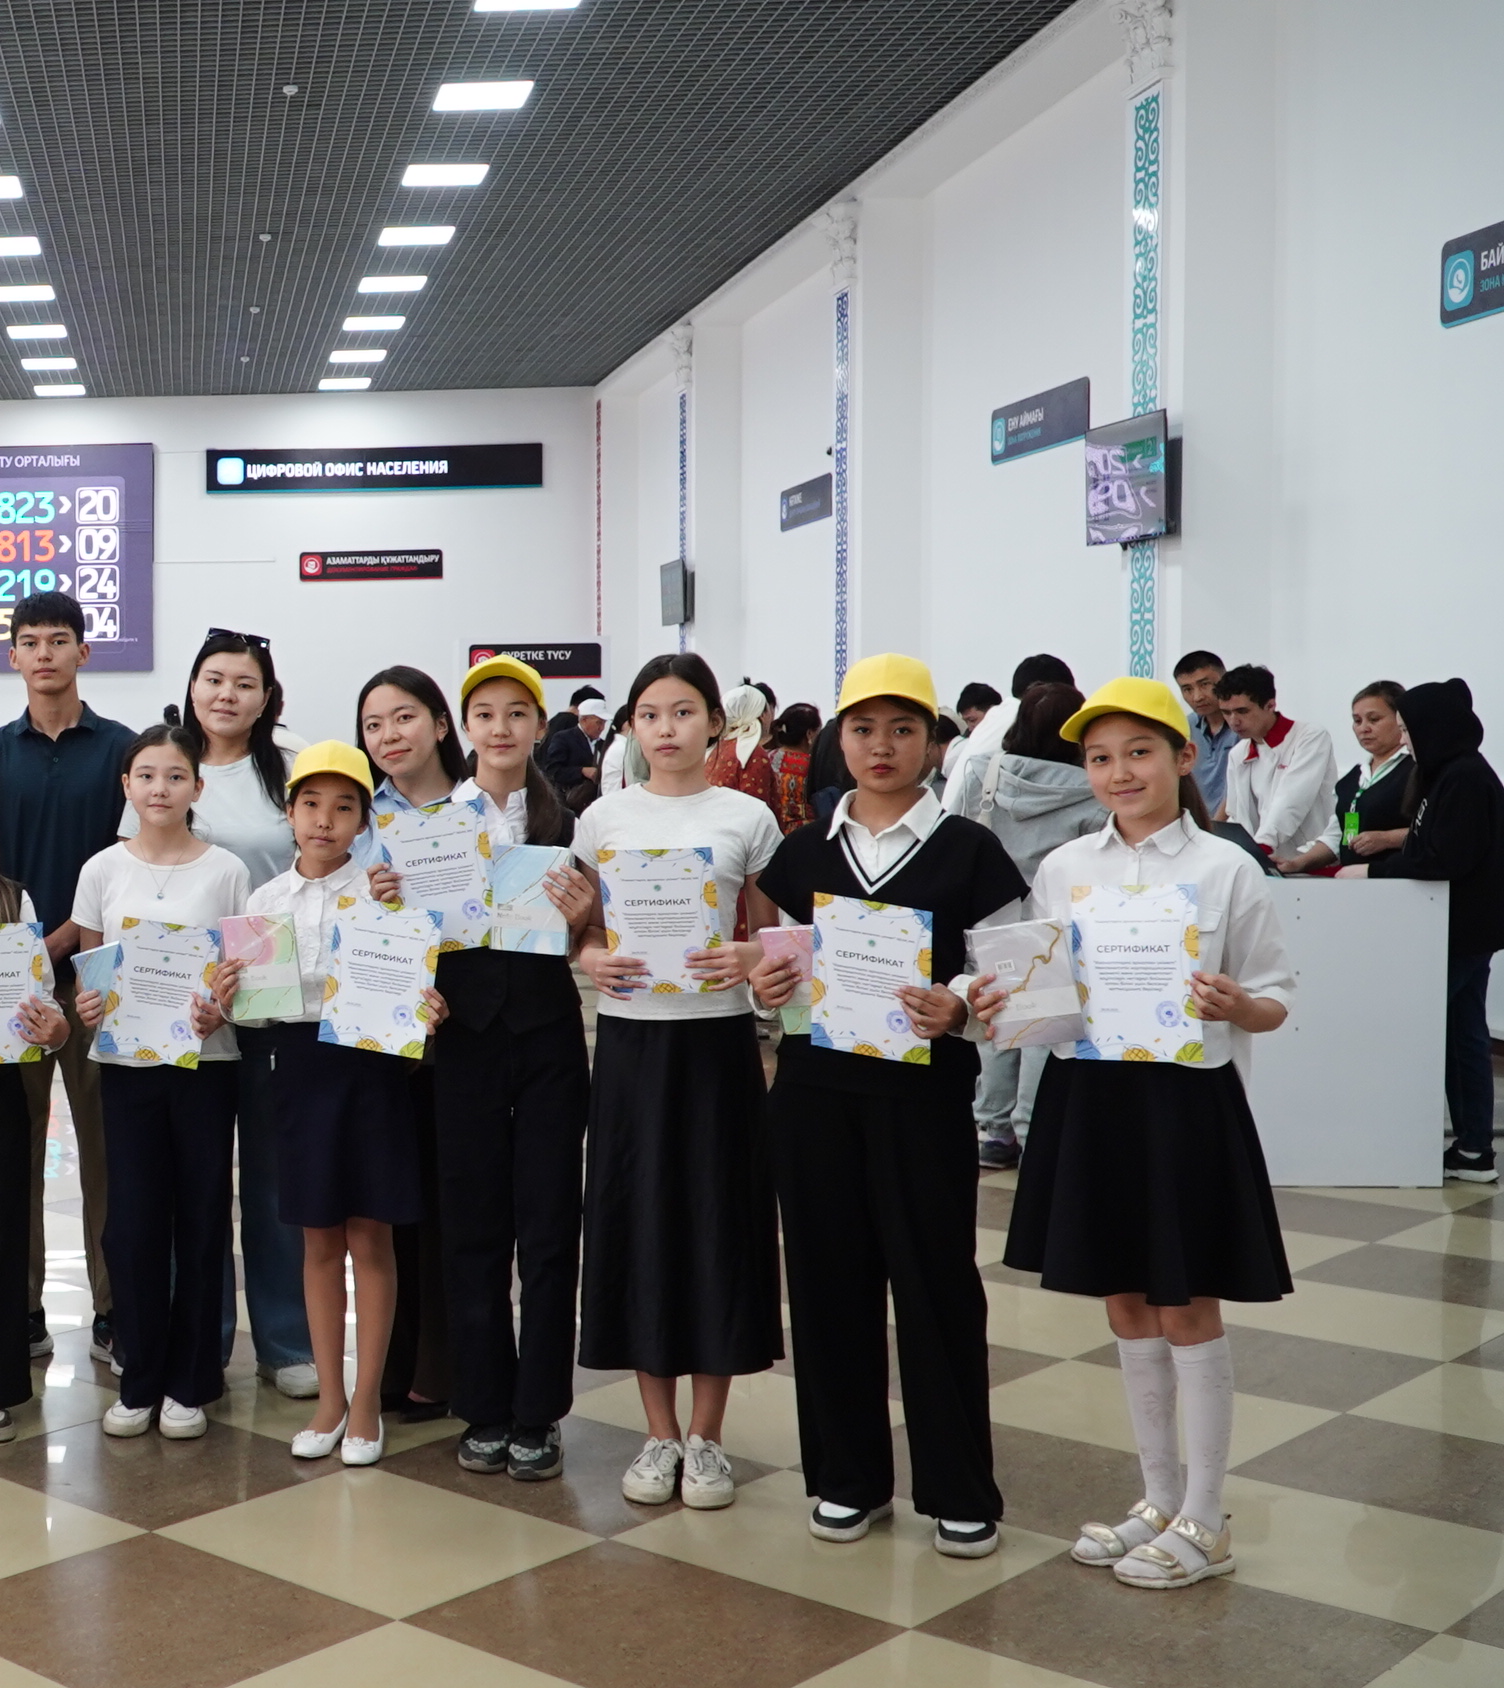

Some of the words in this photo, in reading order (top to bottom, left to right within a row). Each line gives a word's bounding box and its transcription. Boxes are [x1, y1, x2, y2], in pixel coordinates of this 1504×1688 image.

[15, 455, 80, 468] ОРТАЛЫҒЫ
[247, 462, 322, 479] ЦИФРОВОЙ
[325, 462, 363, 477] ОФИС
[366, 460, 448, 475] НАСЕЛЕНИЯ
[79, 489, 117, 522] 20
[78, 529, 117, 560] 09
[326, 556, 380, 565] АЗАМАТТАРДЫ
[79, 567, 117, 599] 24
[405, 851, 468, 868] СЕРТИФИКАТ
[624, 898, 691, 907] СЕРТИФИКАТ
[352, 949, 414, 965] СЕРТИФИКАТ
[1097, 945, 1171, 953] СЕРТИФИКАТ
[835, 950, 905, 968] СЕРТИФИКАТ
[133, 966, 192, 980] СЕРТИФИКАТ
